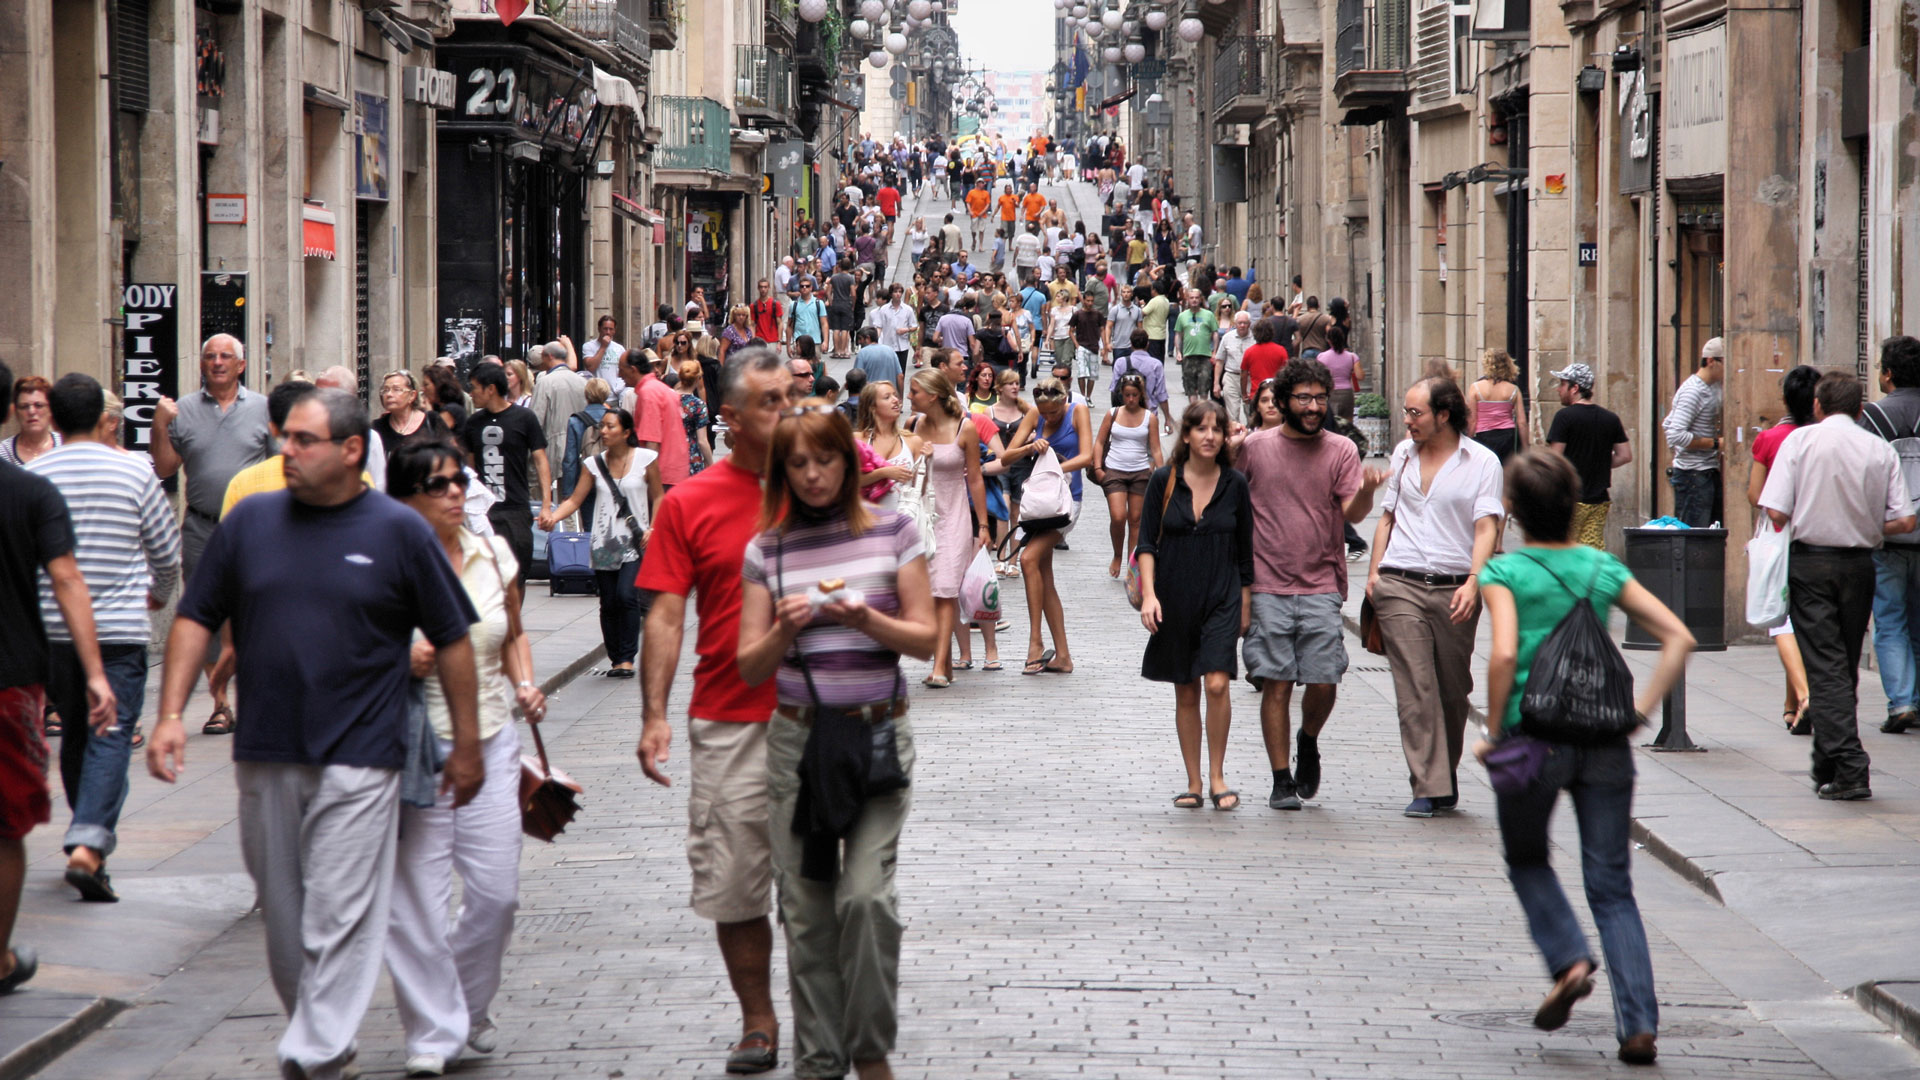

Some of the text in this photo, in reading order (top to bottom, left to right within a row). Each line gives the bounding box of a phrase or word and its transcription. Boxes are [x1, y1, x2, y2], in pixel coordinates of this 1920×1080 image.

[415, 66, 457, 109] HOTEL
[466, 67, 516, 115] 23
[121, 284, 176, 308] ODY
[123, 312, 164, 445] PIERCI
